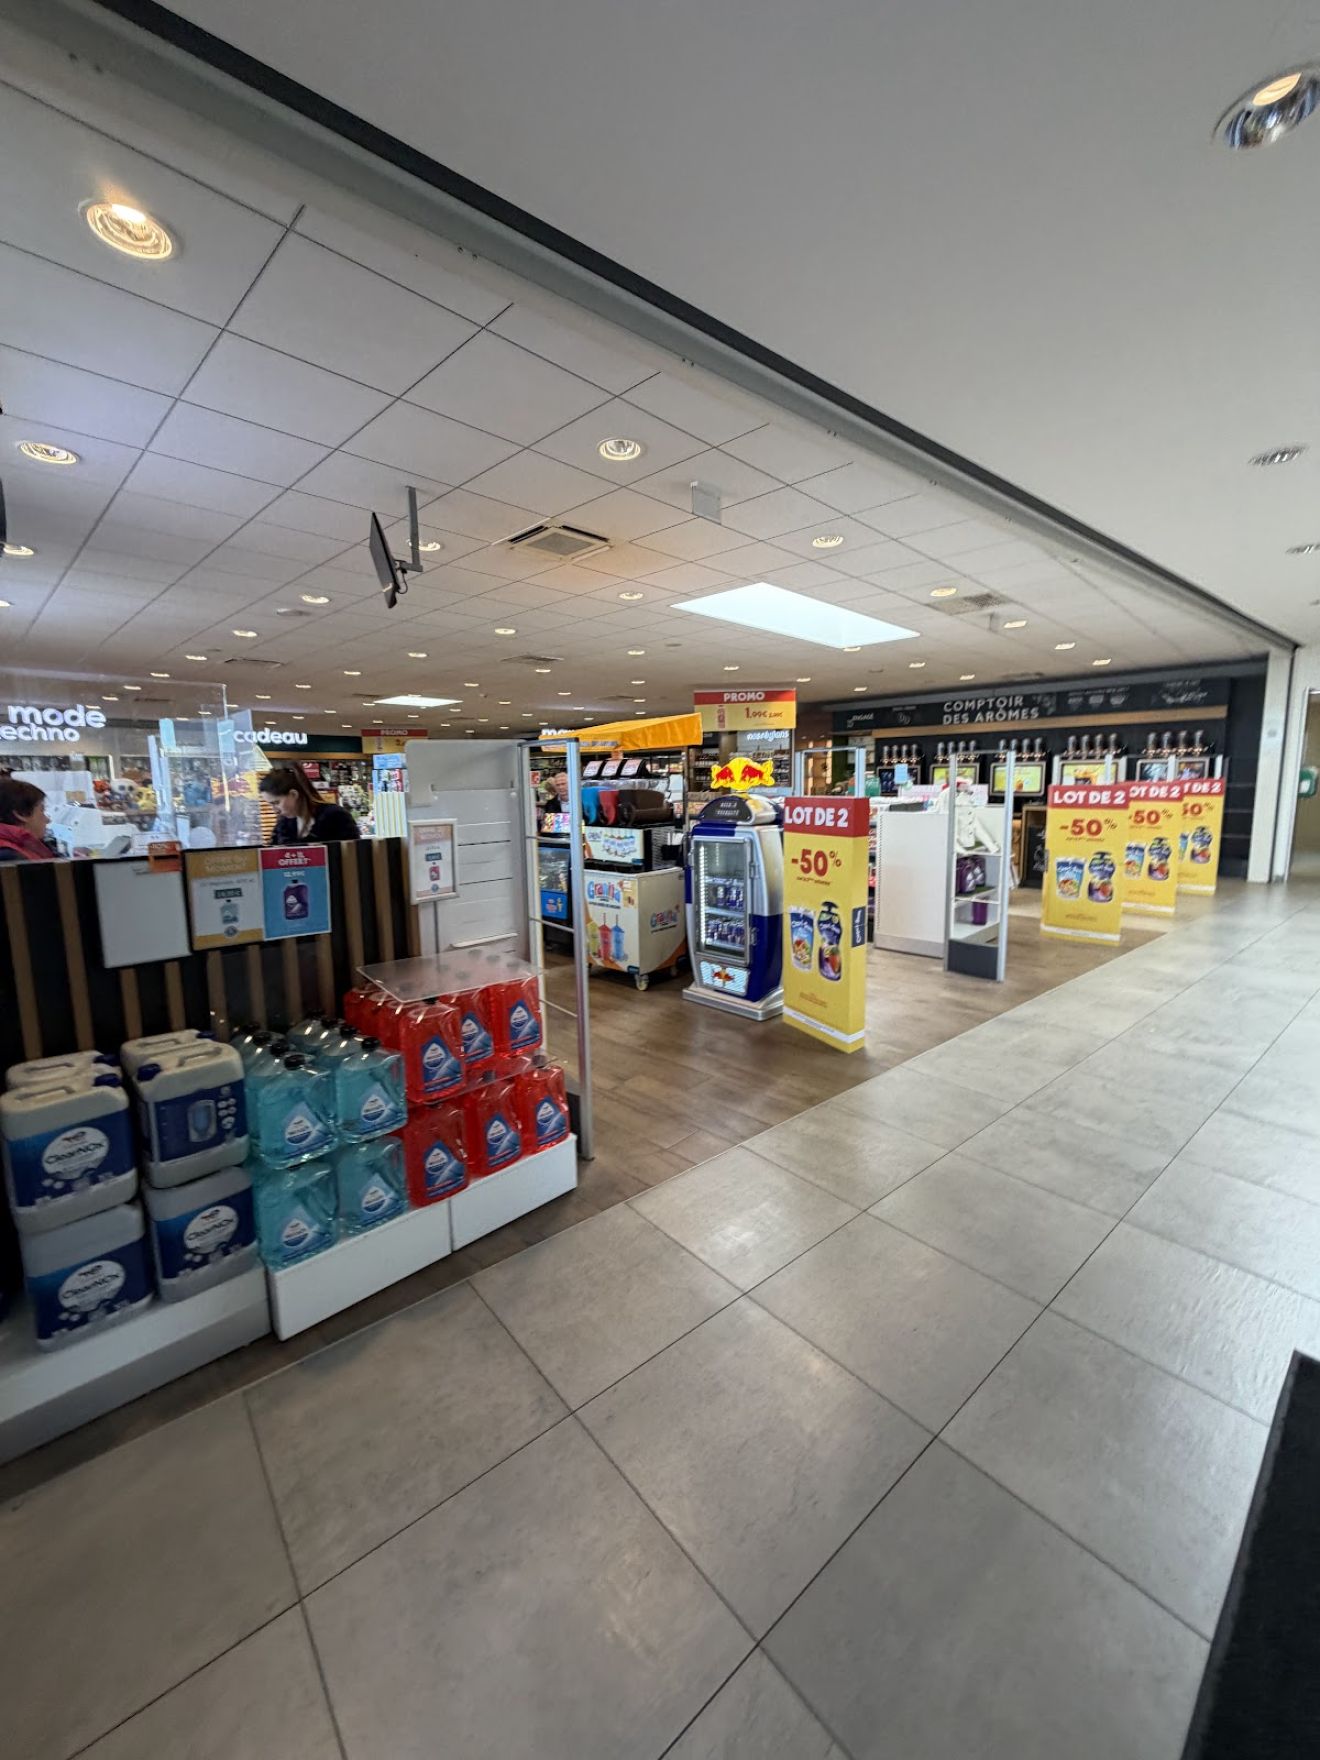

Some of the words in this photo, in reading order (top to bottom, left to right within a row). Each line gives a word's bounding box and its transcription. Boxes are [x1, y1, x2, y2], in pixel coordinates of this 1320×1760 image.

[723, 691, 765, 702] PROMO
[943, 696, 1024, 712] COMPTOIR
[8, 703, 106, 728] mode
[943, 713, 969, 725] DES
[0, 722, 80, 741] echno
[233, 727, 308, 745] cadeau
[1129, 786, 1146, 798] OT
[1149, 786, 1167, 798] DE
[1169, 785, 1181, 798] 2
[1210, 782, 1222, 793] 2
[1053, 790, 1085, 804] LOT
[1089, 791, 1111, 804] DE
[1114, 790, 1126, 804] 2
[784, 805, 813, 825] LOT
[814, 807, 835, 827] DE
[837, 808, 848, 828] 2
[1059, 817, 1118, 836] -50%
[791, 848, 842, 877] -50%
